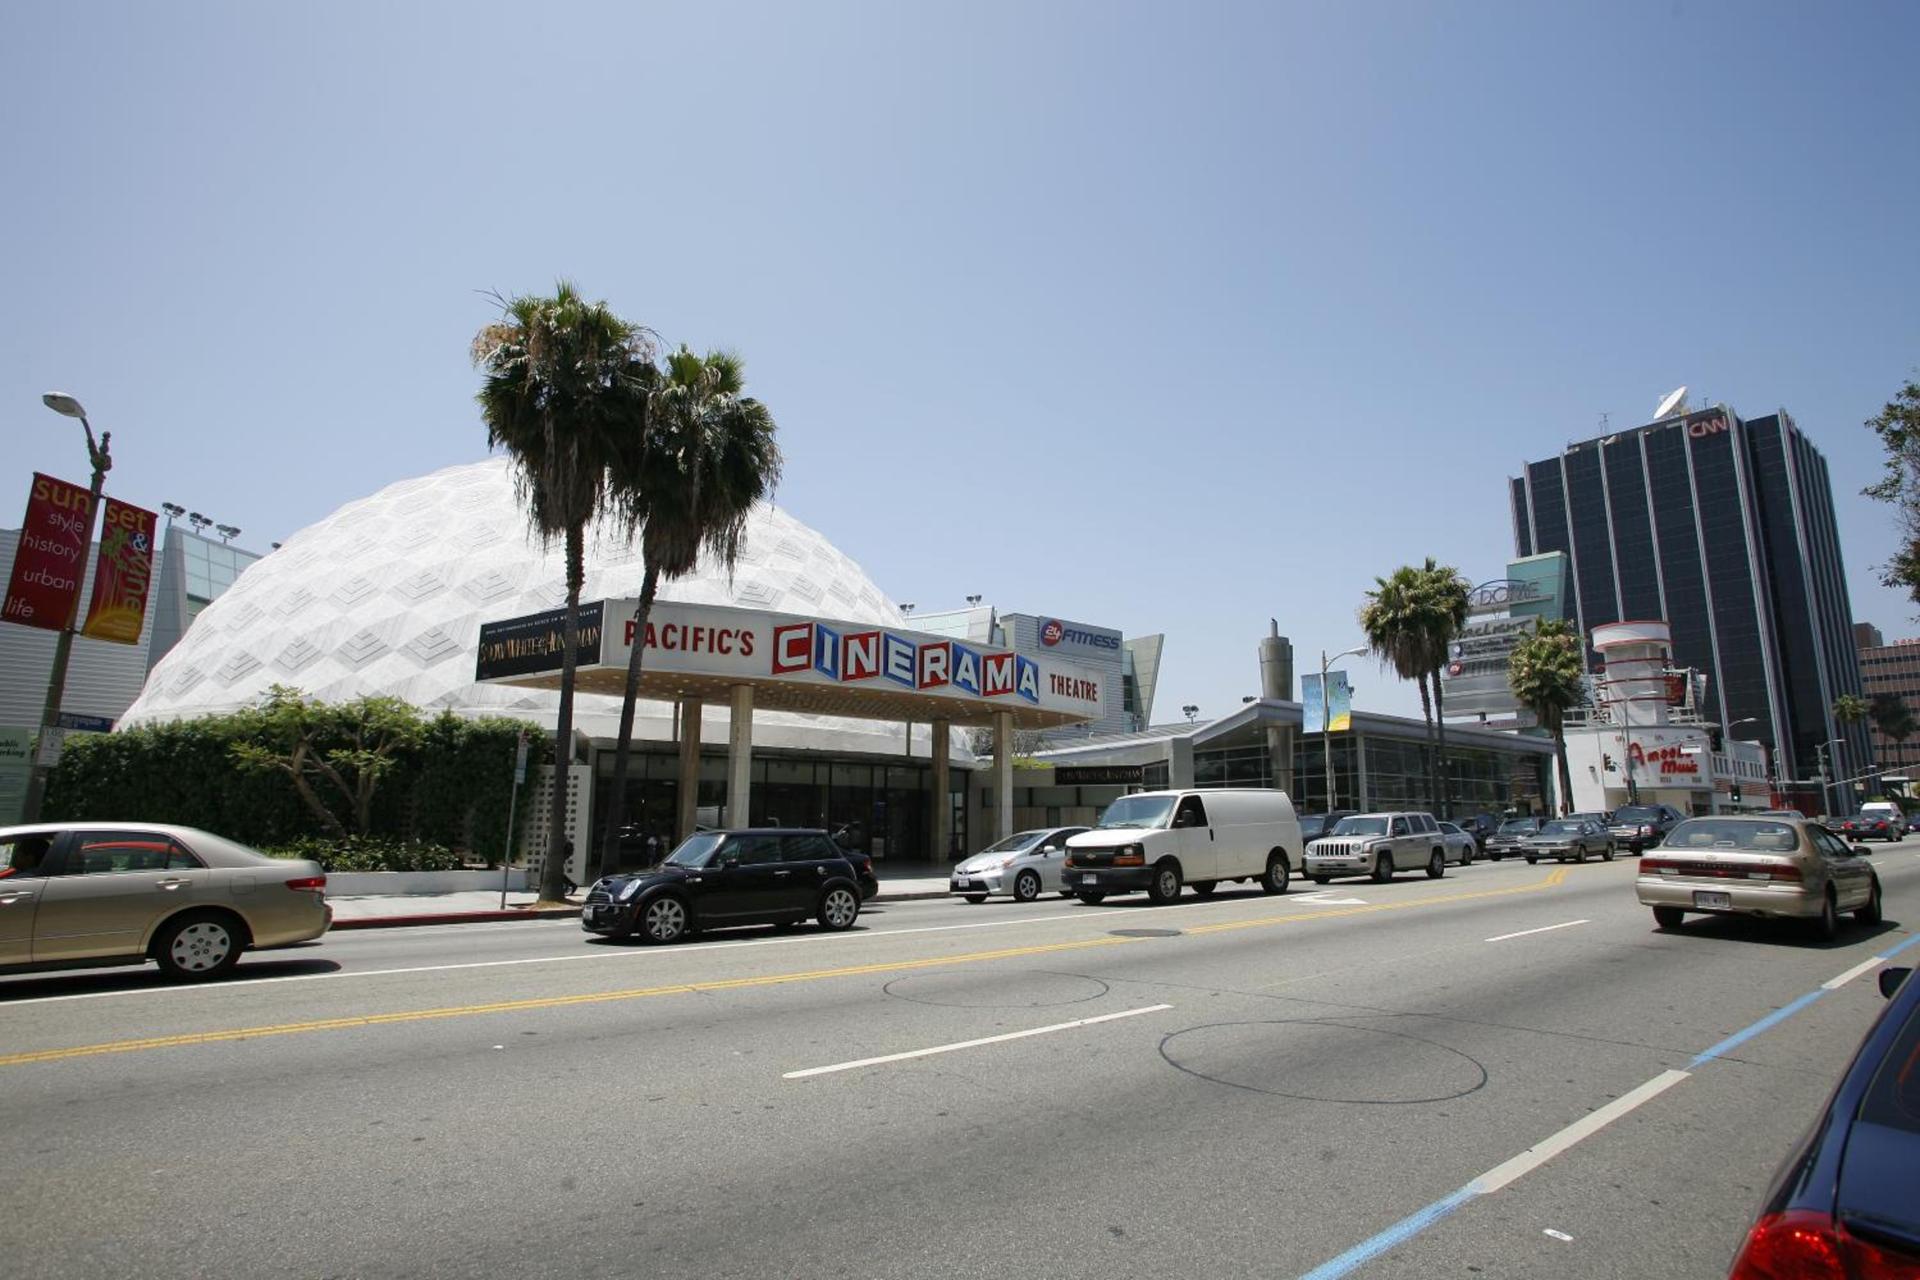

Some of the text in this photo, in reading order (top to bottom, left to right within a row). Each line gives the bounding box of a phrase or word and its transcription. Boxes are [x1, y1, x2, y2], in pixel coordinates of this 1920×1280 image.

[1689, 416, 1728, 437] CNN
[33, 480, 91, 513] sun
[49, 513, 85, 533] style
[107, 504, 147, 533] set
[23, 530, 80, 562] history
[132, 532, 148, 552] &
[24, 568, 75, 591] urban
[6, 595, 34, 618] life
[624, 619, 755, 656] PACIFIC'S
[1046, 625, 1120, 649] 24 FITNESS
[777, 627, 1039, 698] CINERAMA
[1050, 673, 1098, 702] THEATRE
